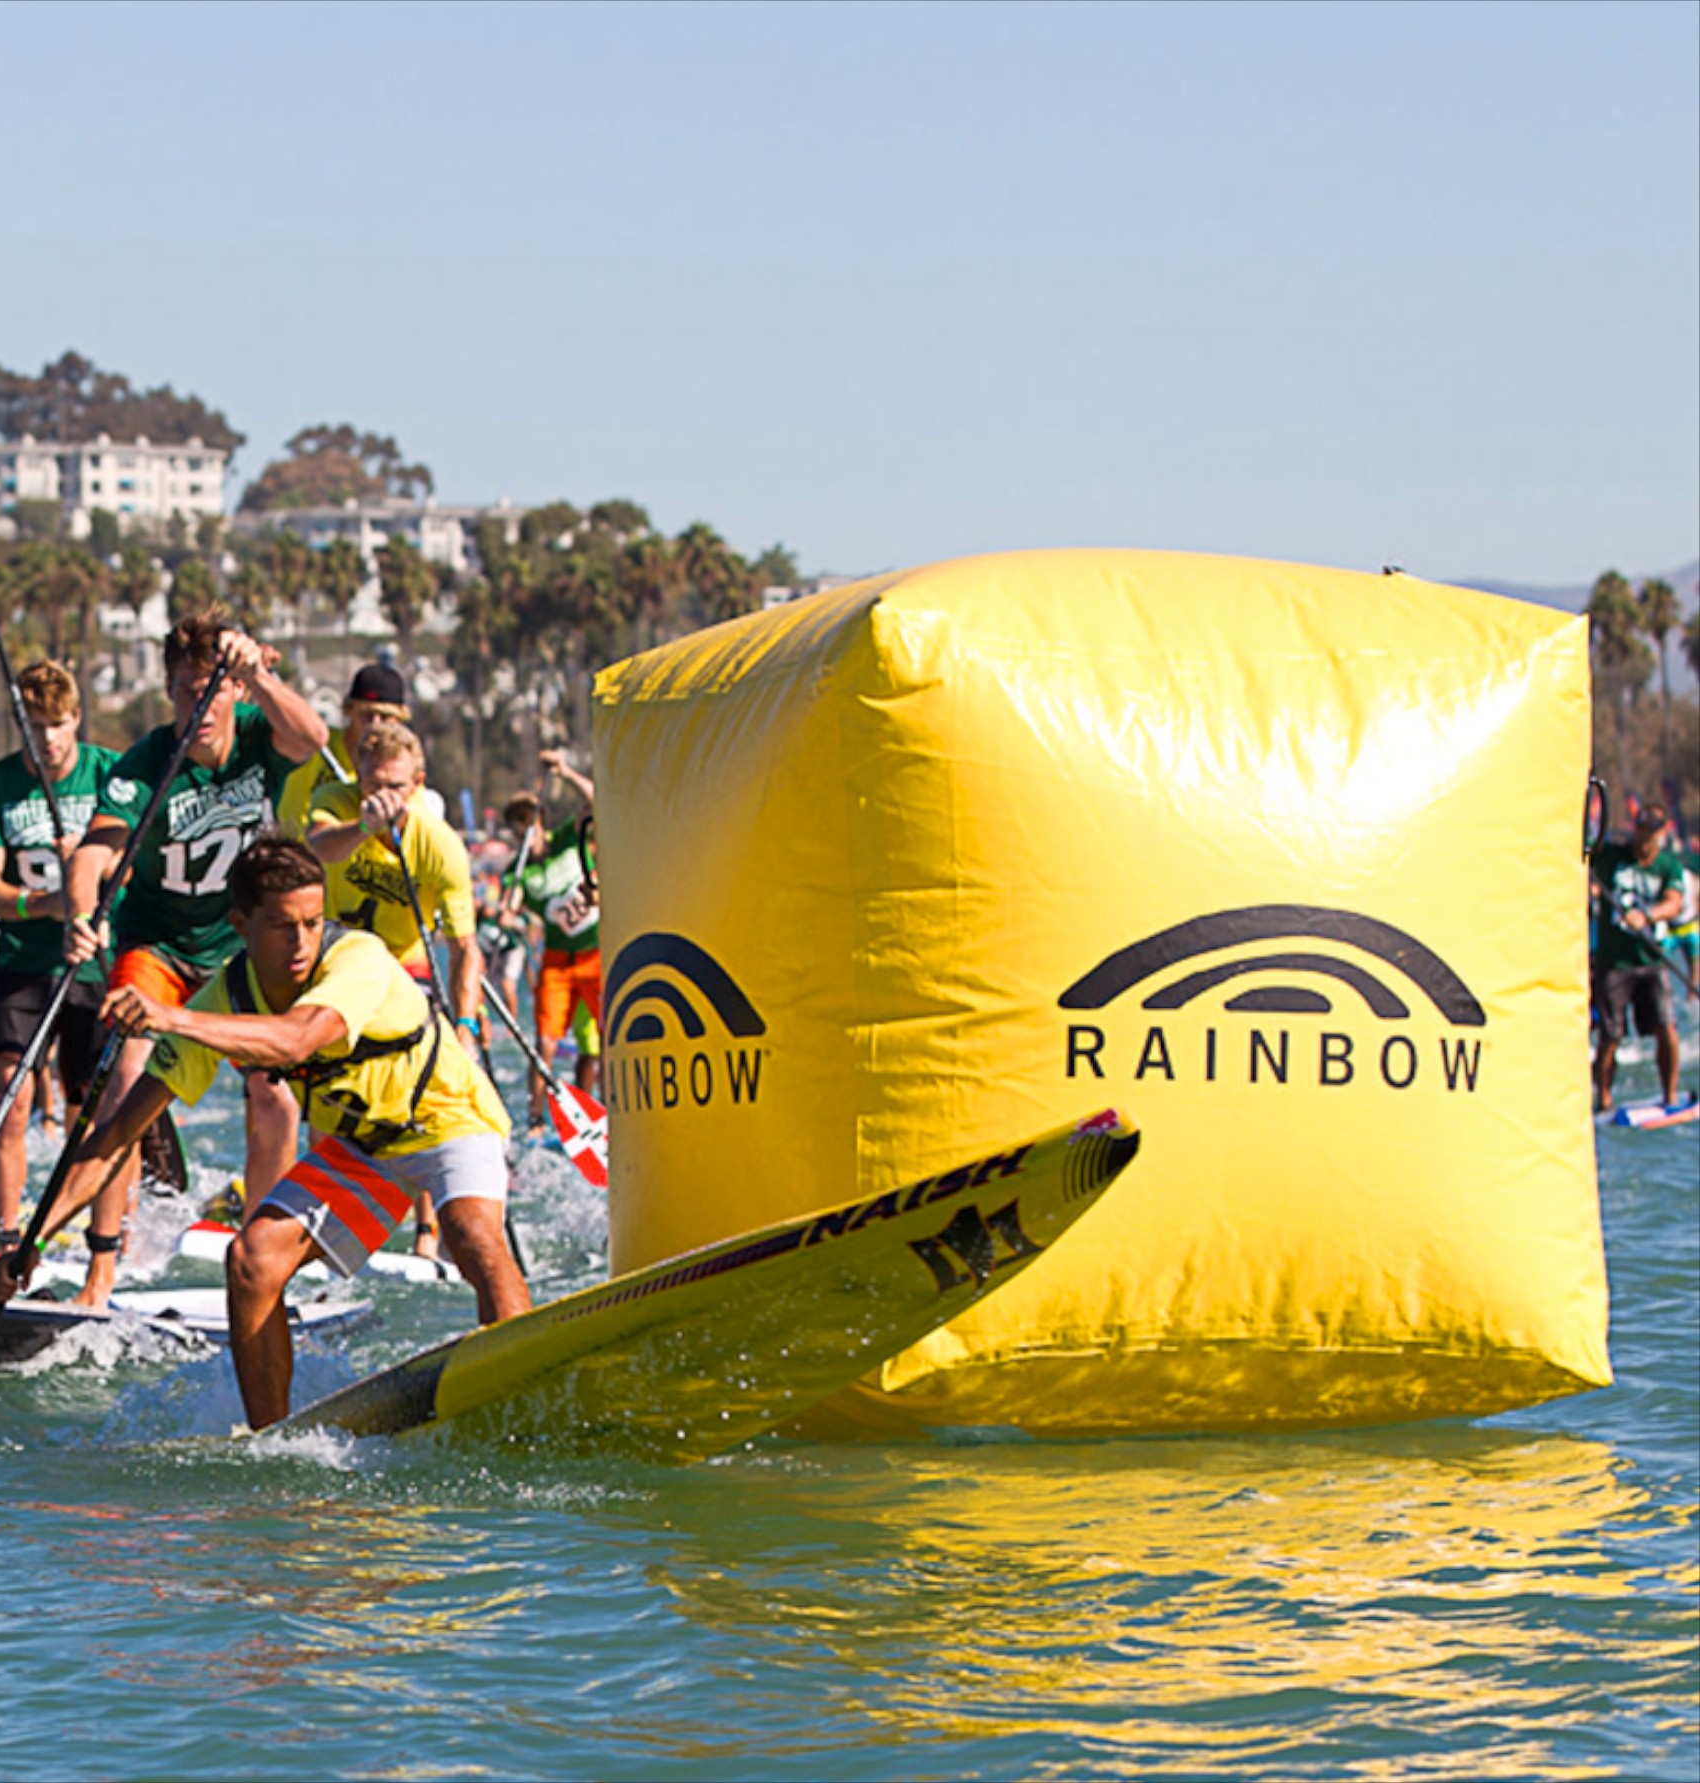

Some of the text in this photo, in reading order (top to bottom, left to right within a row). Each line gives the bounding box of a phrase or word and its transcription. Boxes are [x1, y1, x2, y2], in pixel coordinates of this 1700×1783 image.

[159, 810, 266, 896] 17
[608, 1048, 761, 1114] AINBOW
[1065, 1024, 1482, 1092] RAINBOW
[805, 1143, 1036, 1247] NAISH
